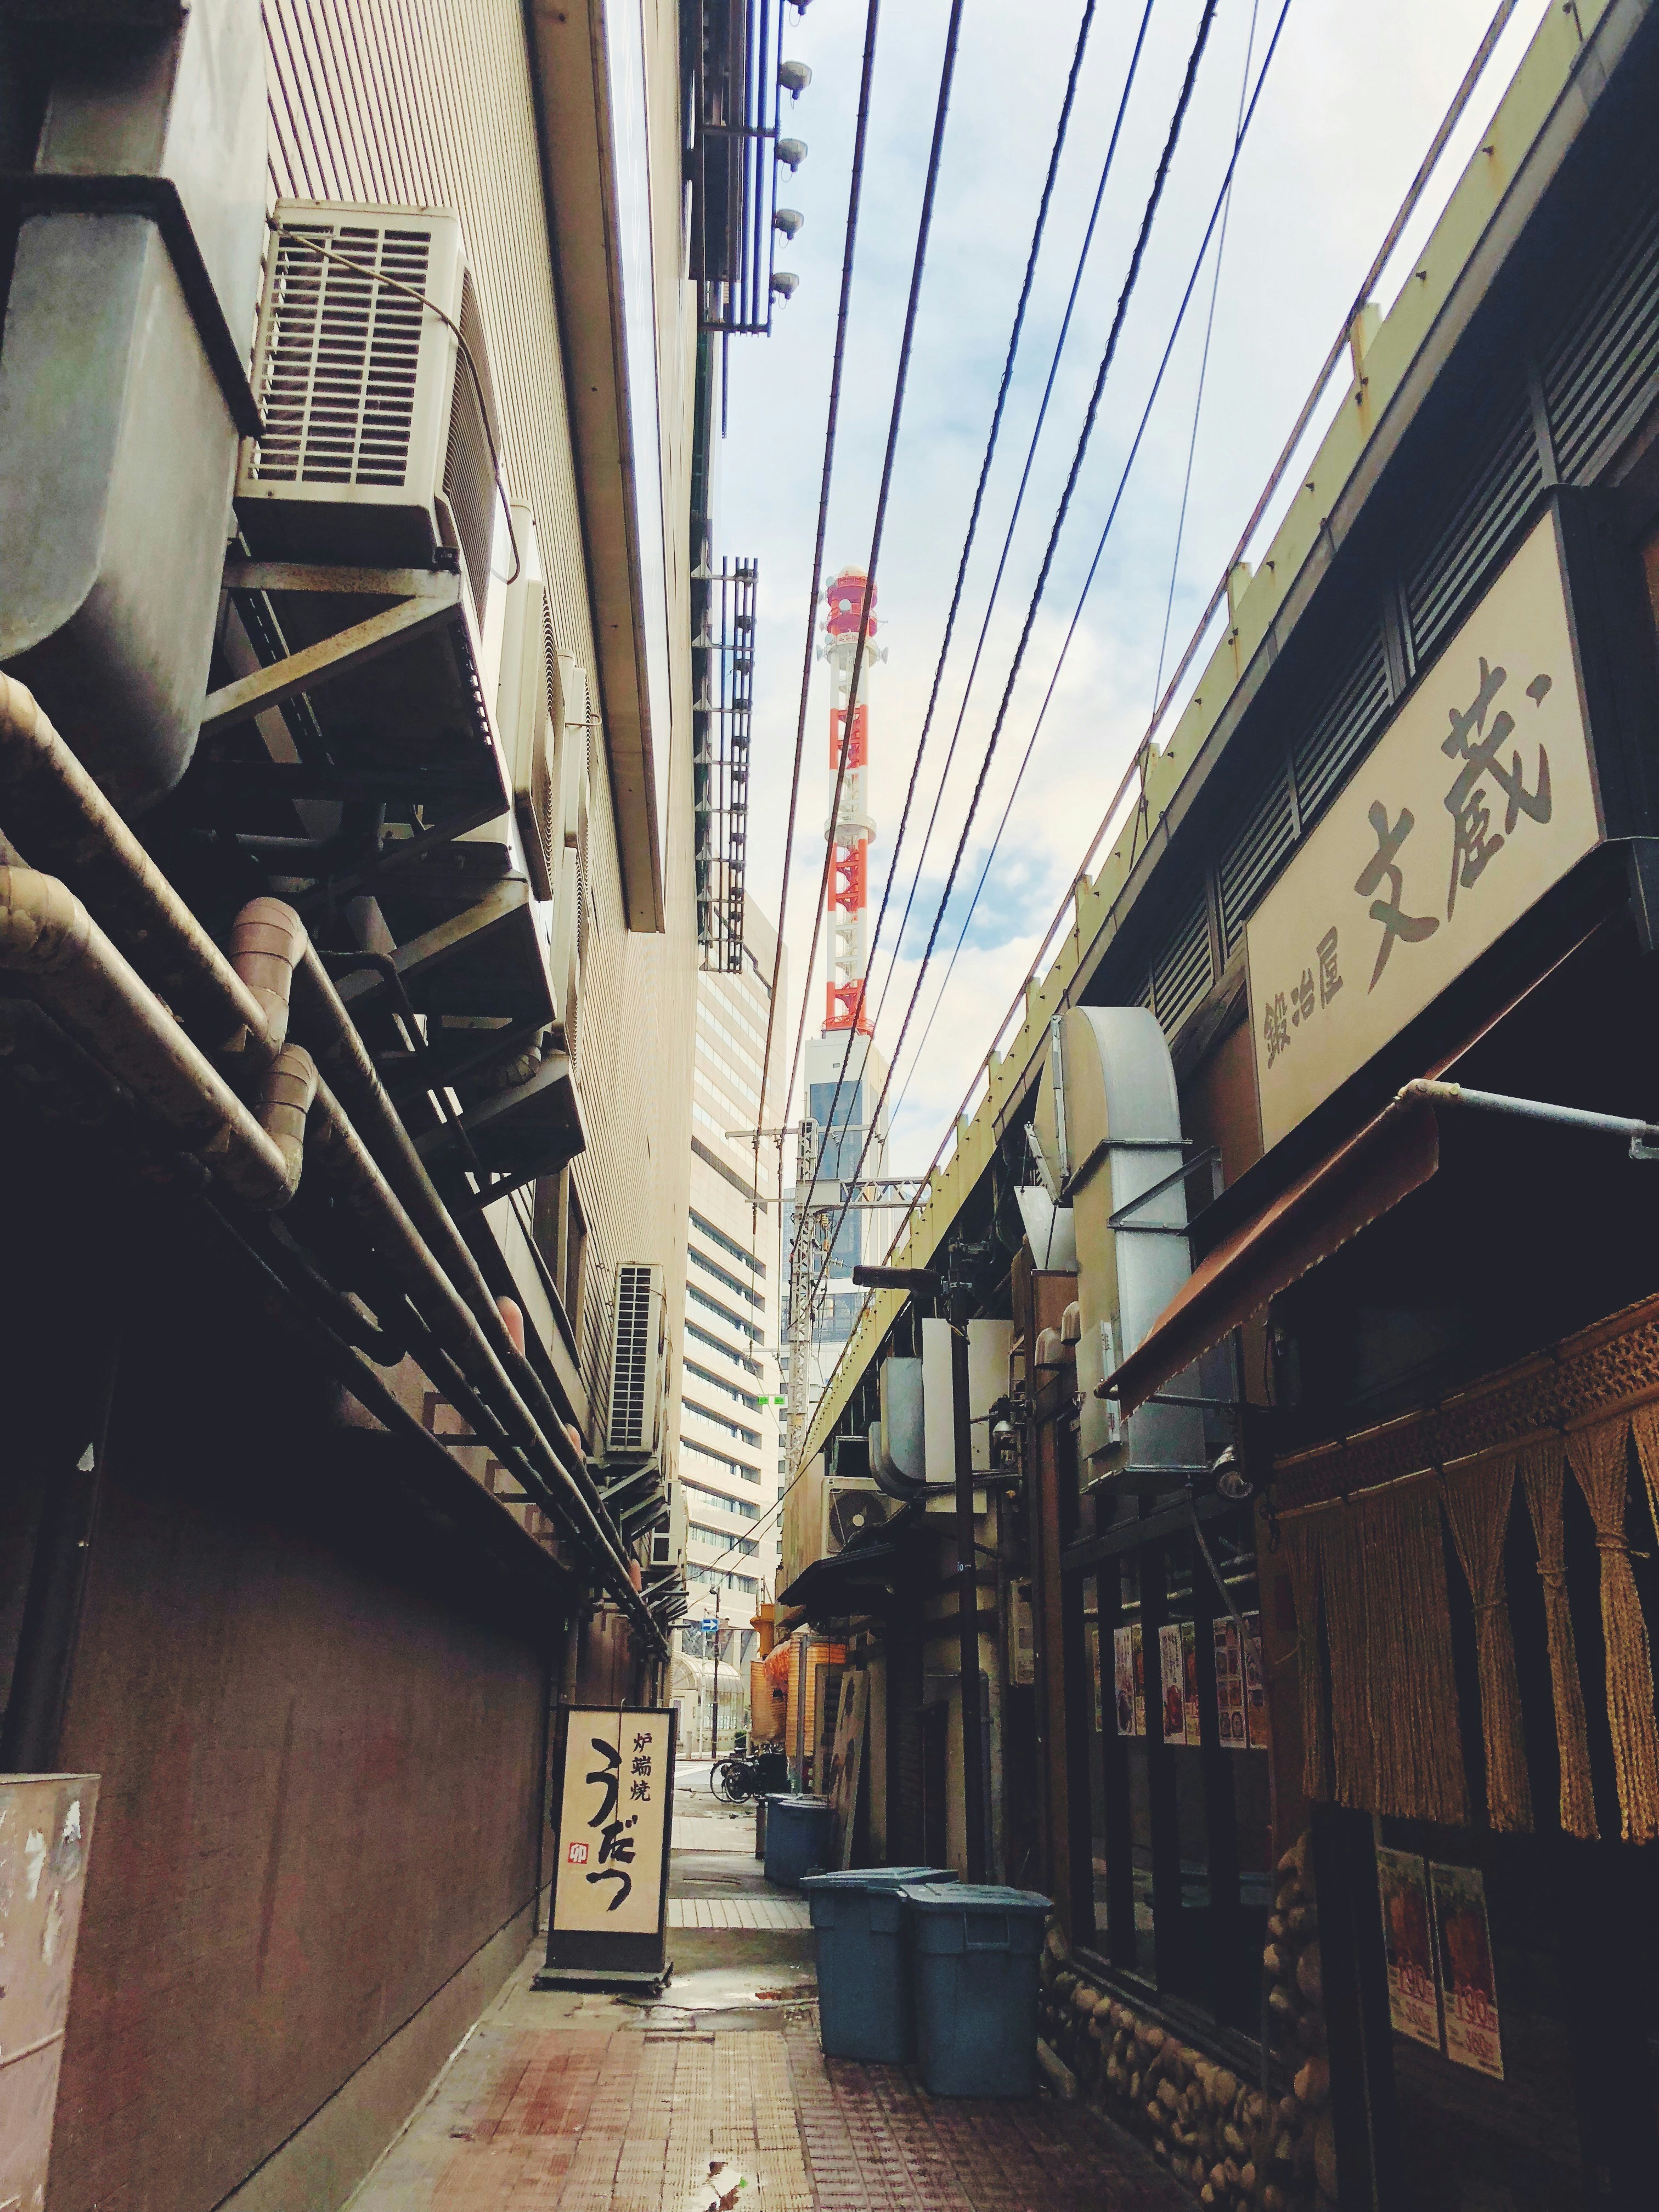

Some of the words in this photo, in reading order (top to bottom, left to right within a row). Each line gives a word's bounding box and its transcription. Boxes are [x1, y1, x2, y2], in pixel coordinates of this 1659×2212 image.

[1263, 926, 1344, 1069] 鍛冶屋
[586, 1738, 638, 1912] うだつ
[630, 1733, 653, 1802] 炉端焼
